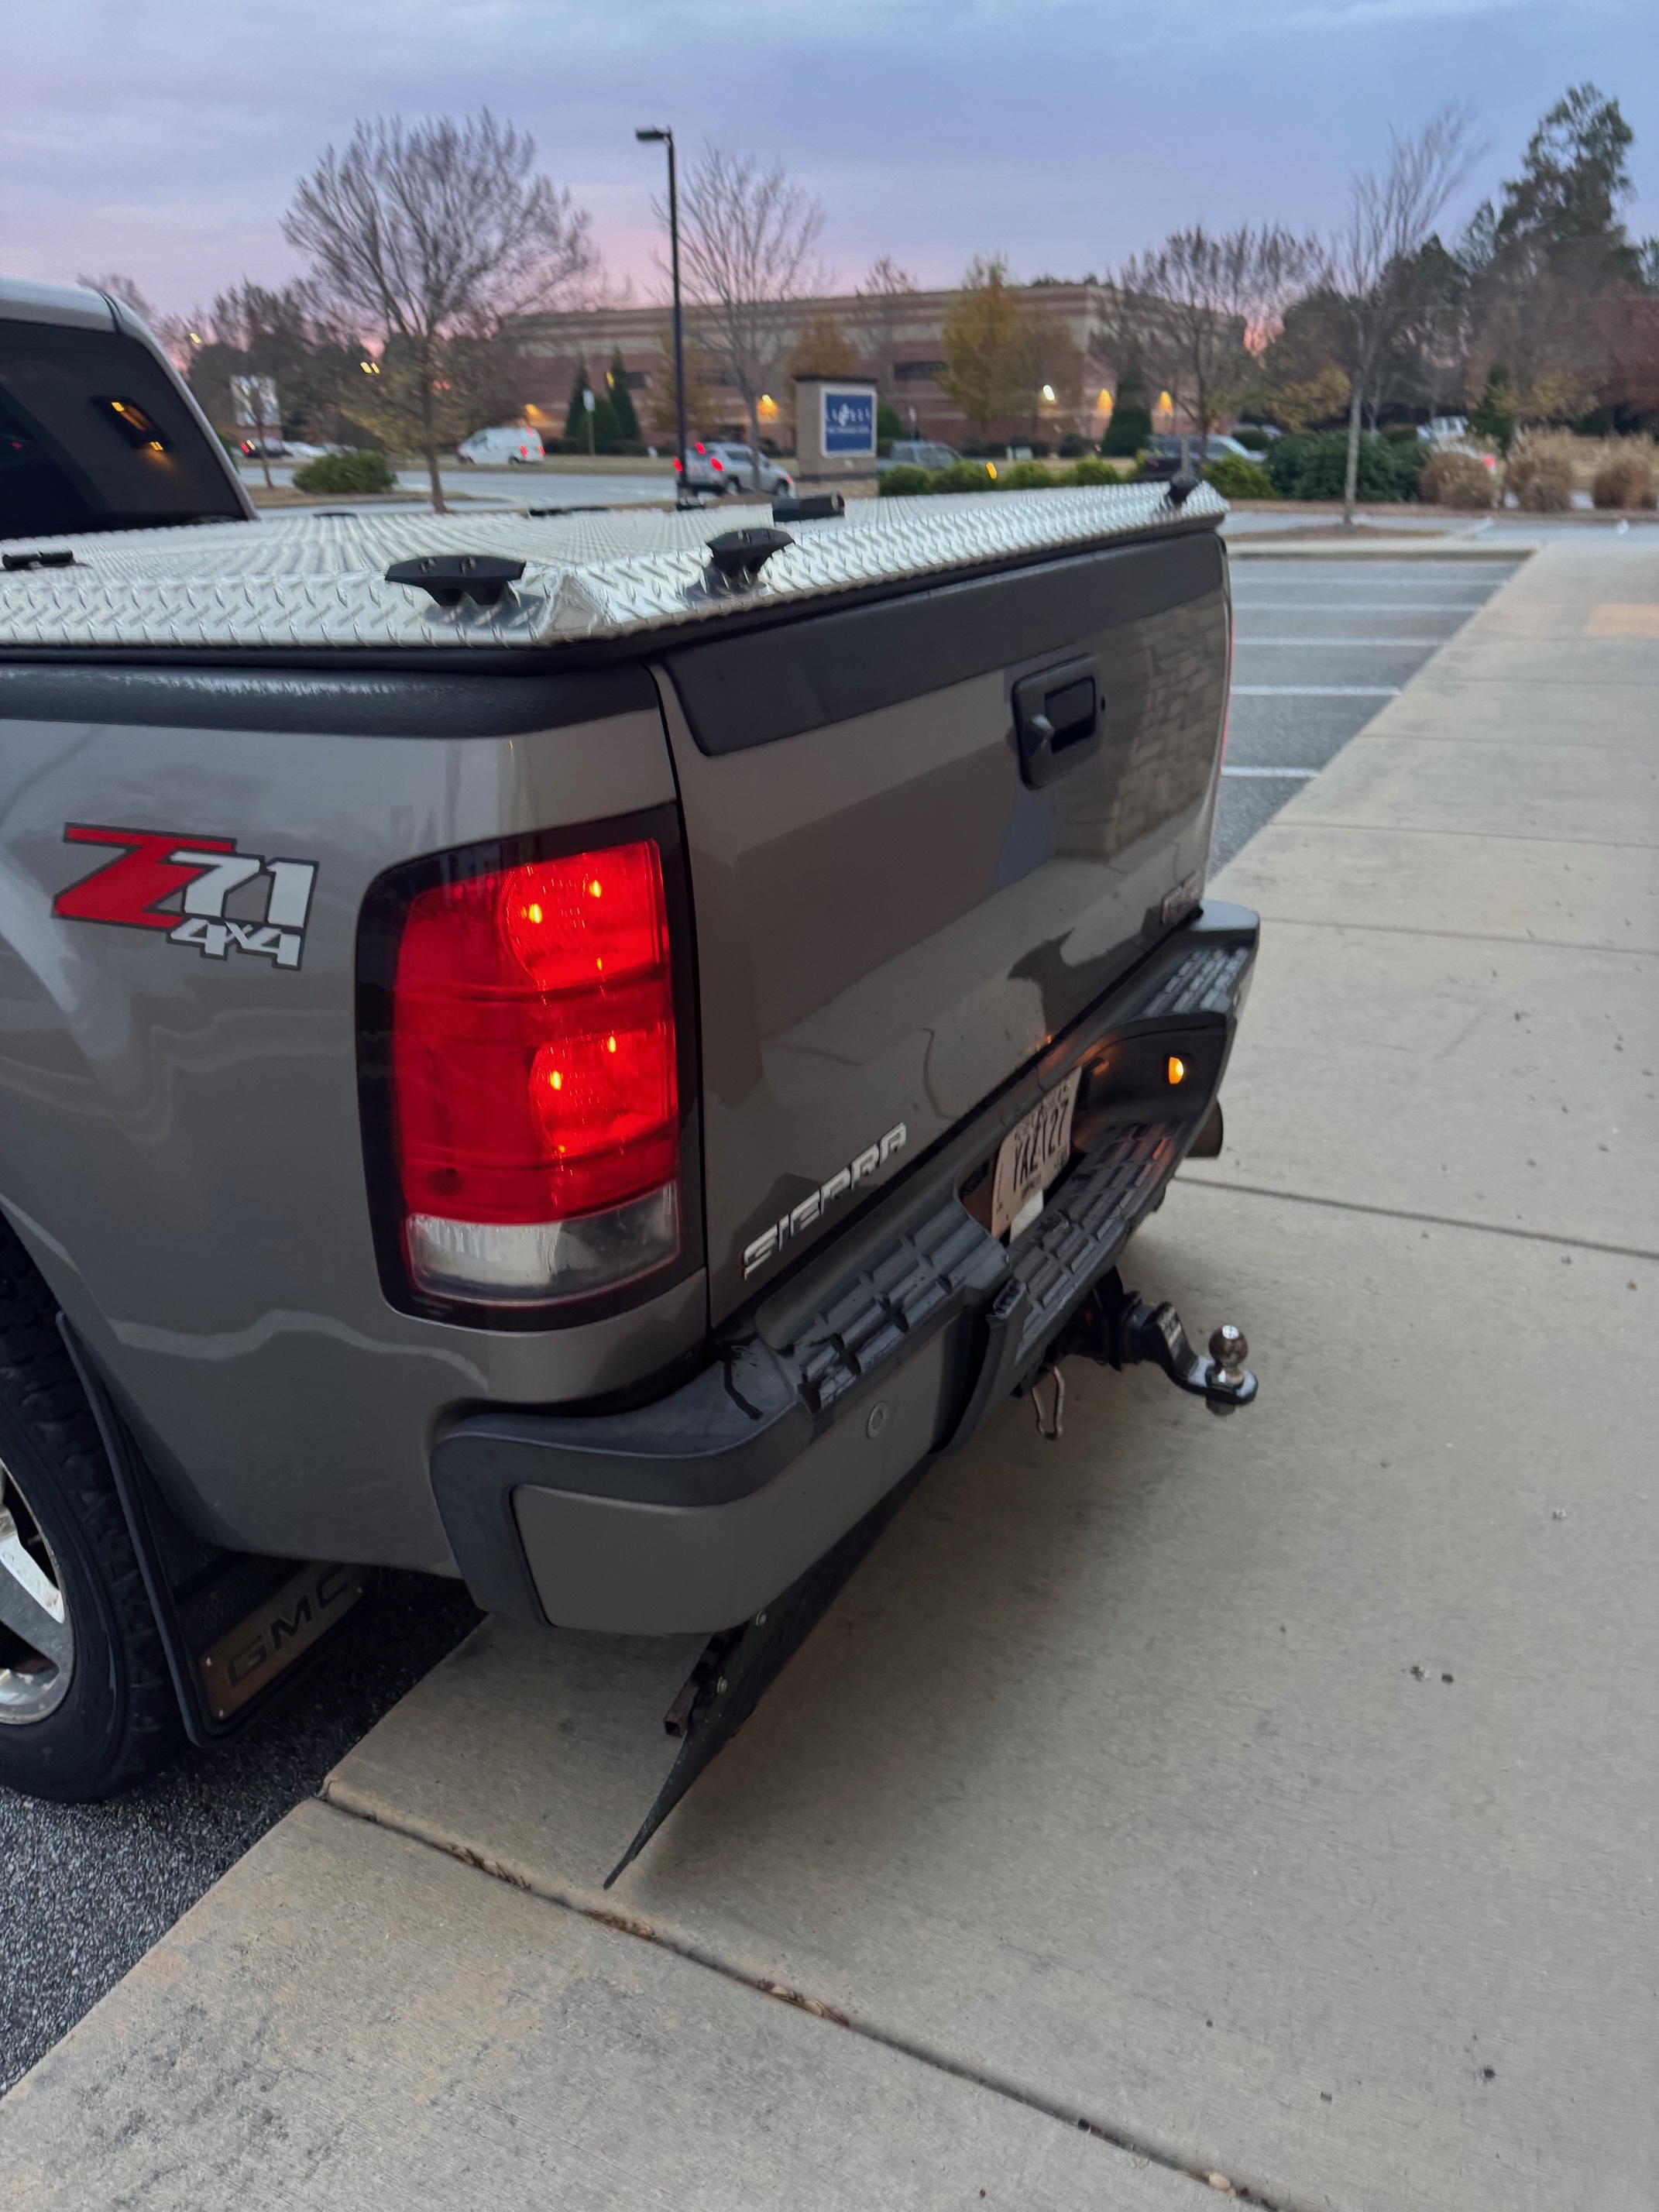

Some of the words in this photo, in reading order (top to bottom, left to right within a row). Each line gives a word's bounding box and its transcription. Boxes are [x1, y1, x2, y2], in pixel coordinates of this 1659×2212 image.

[53, 822, 319, 931] Z71
[741, 1121, 907, 1280] SIERRA
[227, 1564, 350, 1688] GMC
